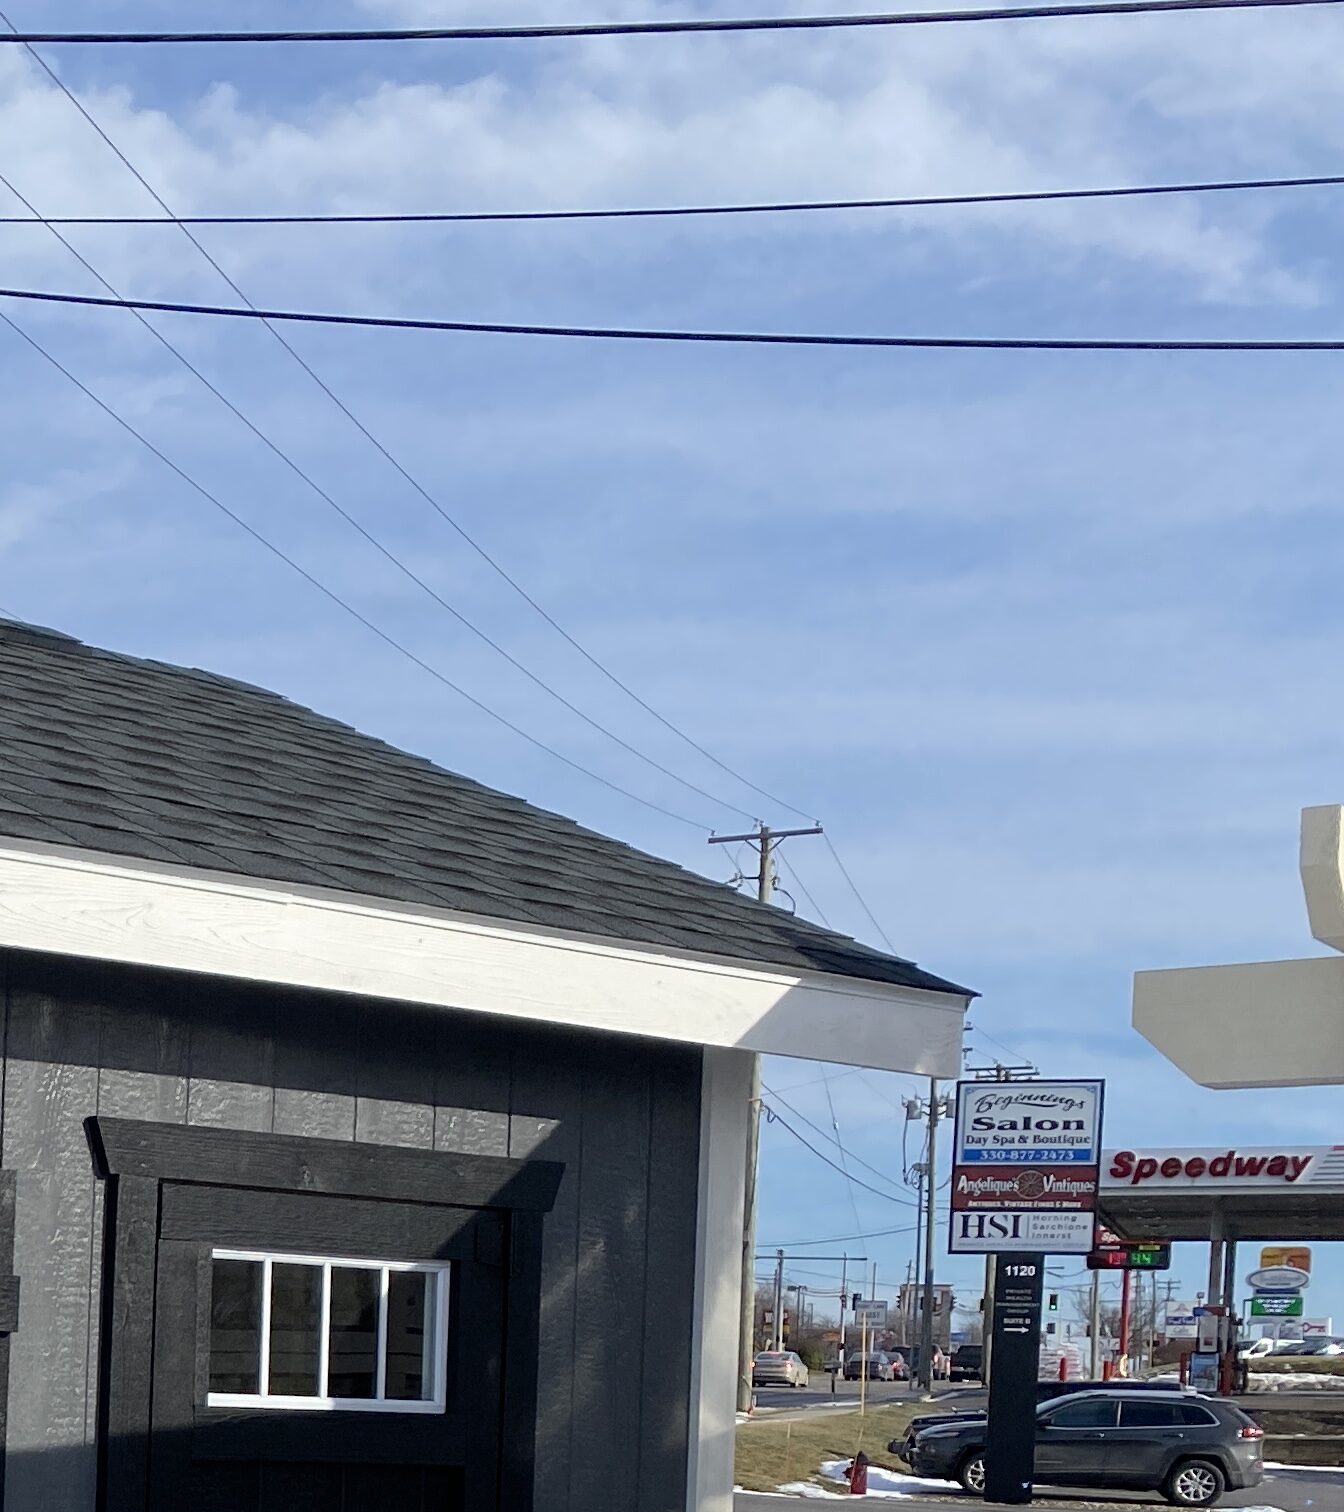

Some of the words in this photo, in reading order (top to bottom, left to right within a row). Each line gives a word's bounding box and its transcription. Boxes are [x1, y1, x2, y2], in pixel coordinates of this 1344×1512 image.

[974, 1093, 1086, 1113] Beginnings
[971, 1116, 1085, 1131] Salon
[965, 1135, 988, 1146] Day
[992, 1134, 1015, 1146] Spa
[1018, 1135, 1029, 1144] &
[1032, 1134, 1091, 1146] Boutique
[980, 1150, 1074, 1160] 330-877-2473
[1109, 1150, 1314, 1185] Speedway
[957, 1174, 1020, 1197] Angelique's
[1043, 1174, 1096, 1197] Vintiques
[1032, 1215, 1078, 1223] Horning
[959, 1214, 1023, 1239] HSI
[1032, 1223, 1089, 1231] Sarchione
[1005, 1265, 1036, 1276] 1120
